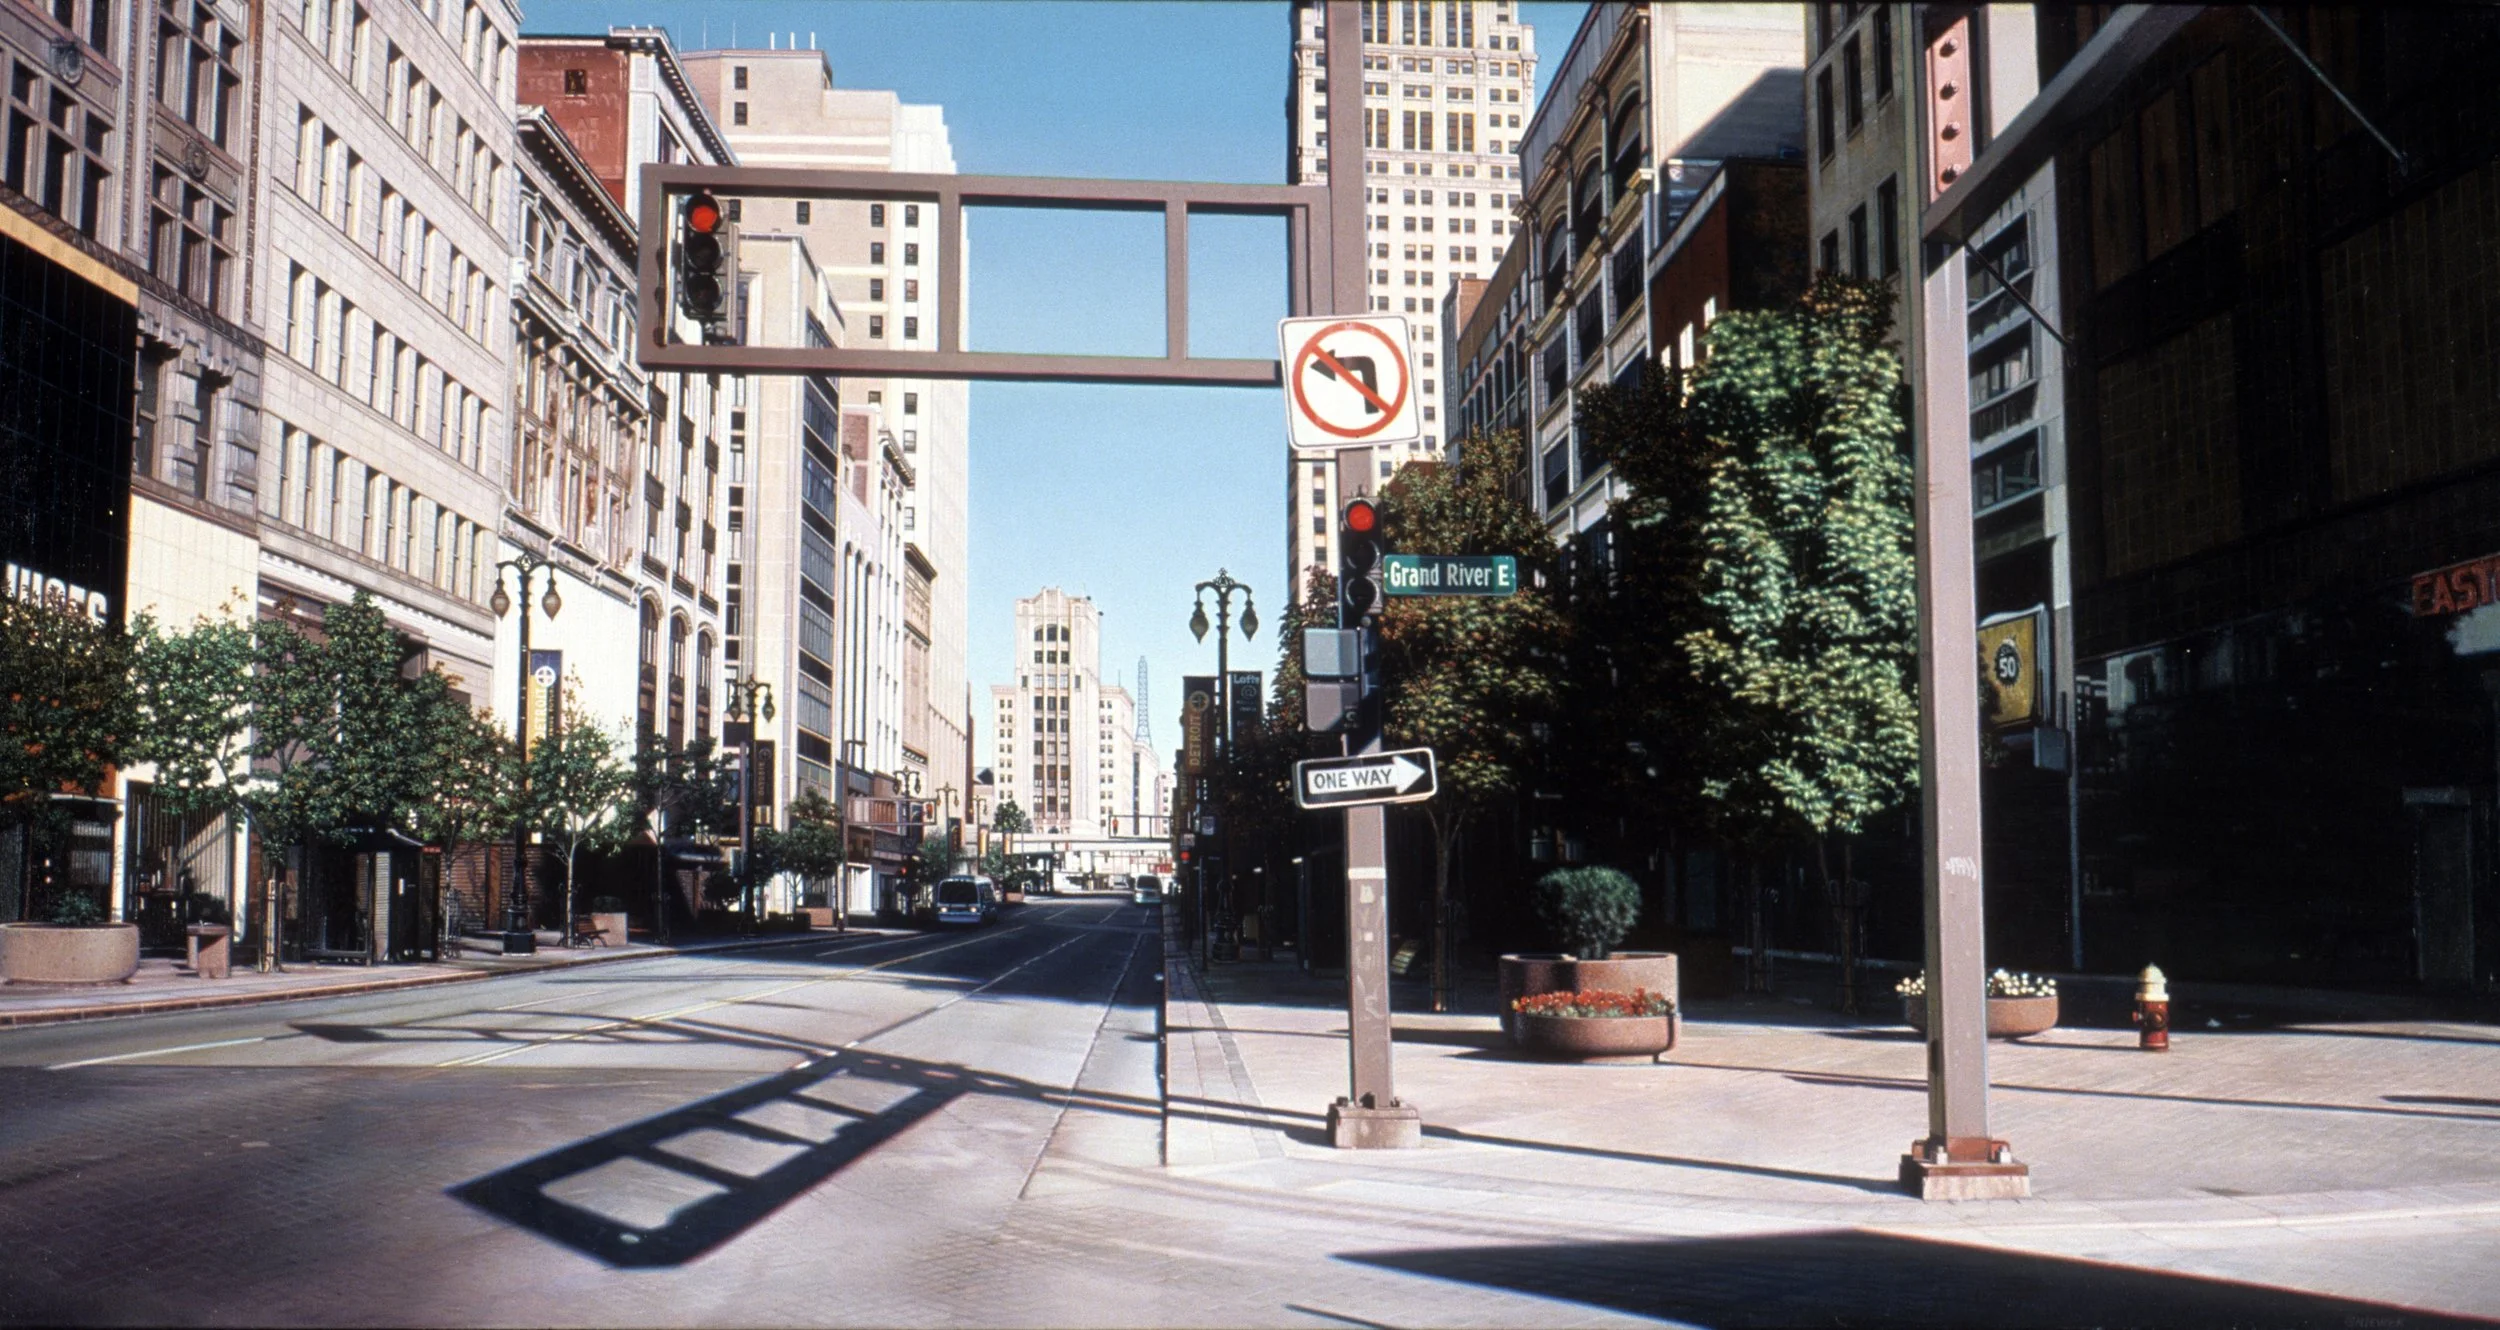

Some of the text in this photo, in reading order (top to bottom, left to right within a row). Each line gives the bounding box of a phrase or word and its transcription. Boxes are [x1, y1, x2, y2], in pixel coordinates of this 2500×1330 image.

[1390, 561, 1511, 587] Grand River E
[2412, 558, 2500, 616] EAST
[1999, 656, 2016, 678] 50
[1189, 713, 1201, 767] DETROIT
[1314, 768, 1392, 789] ONE WAY
